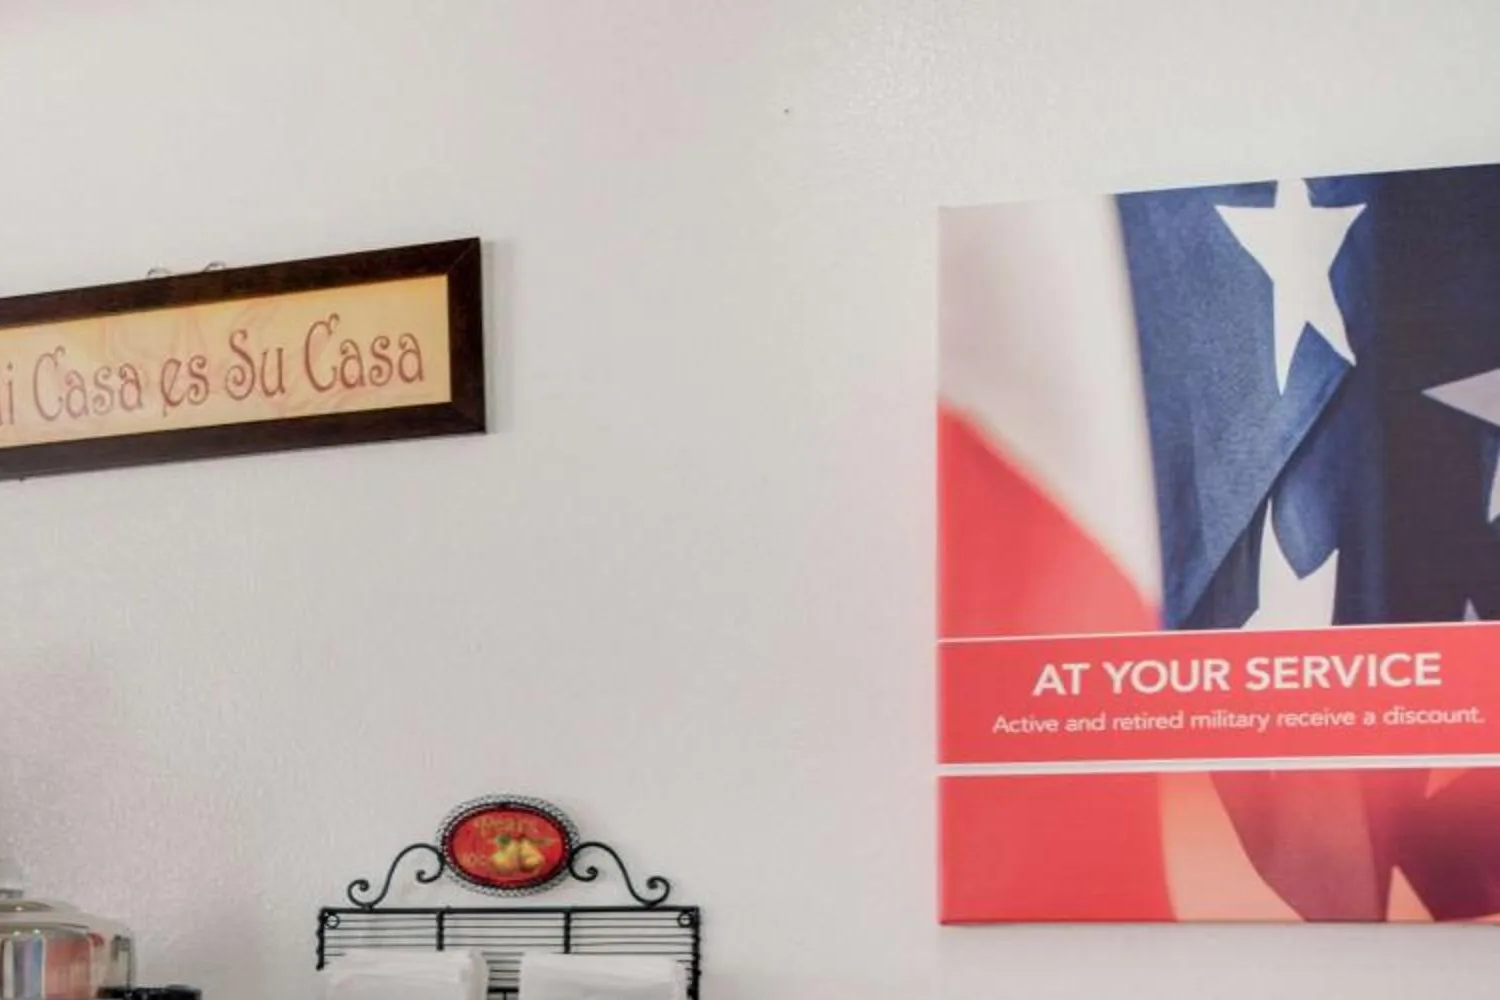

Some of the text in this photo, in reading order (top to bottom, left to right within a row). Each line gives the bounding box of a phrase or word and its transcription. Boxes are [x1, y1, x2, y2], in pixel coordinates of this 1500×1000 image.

[32, 345, 145, 422] Casa
[159, 354, 210, 417] es
[224, 329, 286, 401] Su
[304, 312, 424, 393] Casa
[1032, 652, 1442, 696] AT YOUR SERVICE
[992, 705, 1485, 733] Active and retired military receive a discount.
